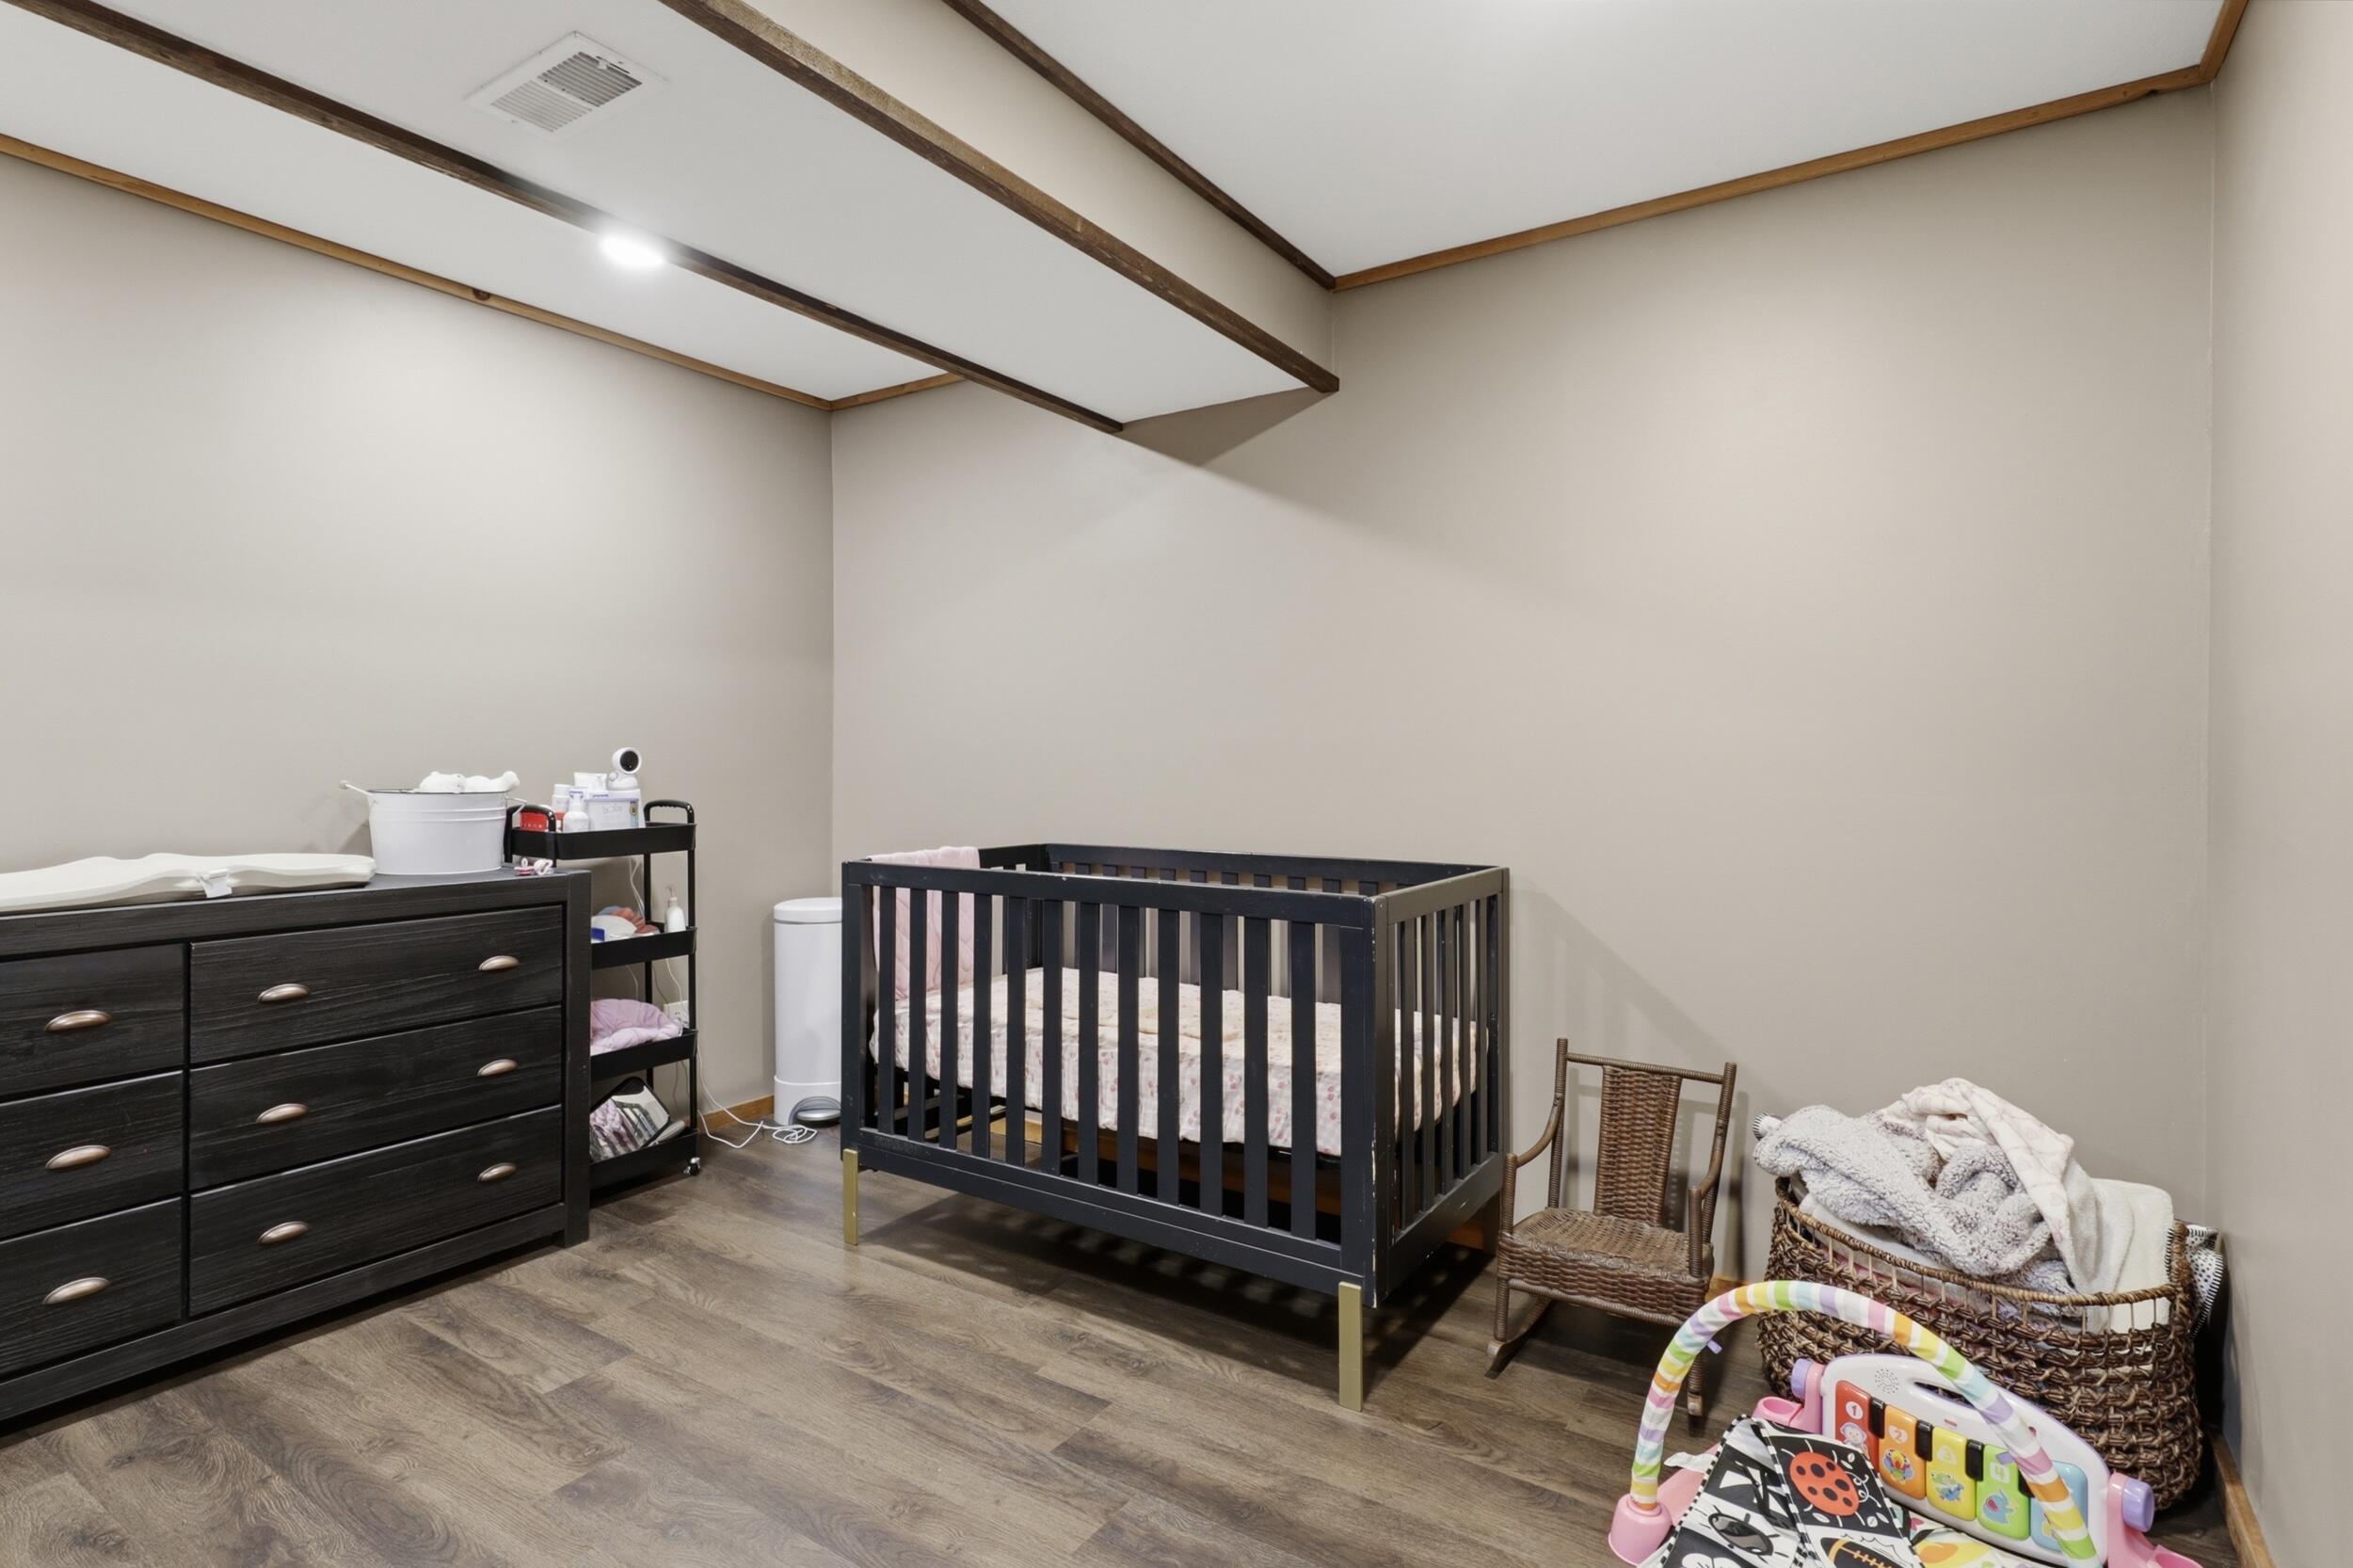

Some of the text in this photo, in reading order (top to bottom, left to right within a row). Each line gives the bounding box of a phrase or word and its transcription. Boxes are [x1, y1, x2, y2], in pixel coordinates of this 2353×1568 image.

[1851, 1405, 1857, 1416] 1
[1895, 1430, 1902, 1442] 2
[1943, 1448, 1951, 1461] 3
[1994, 1464, 2005, 1480] 4
